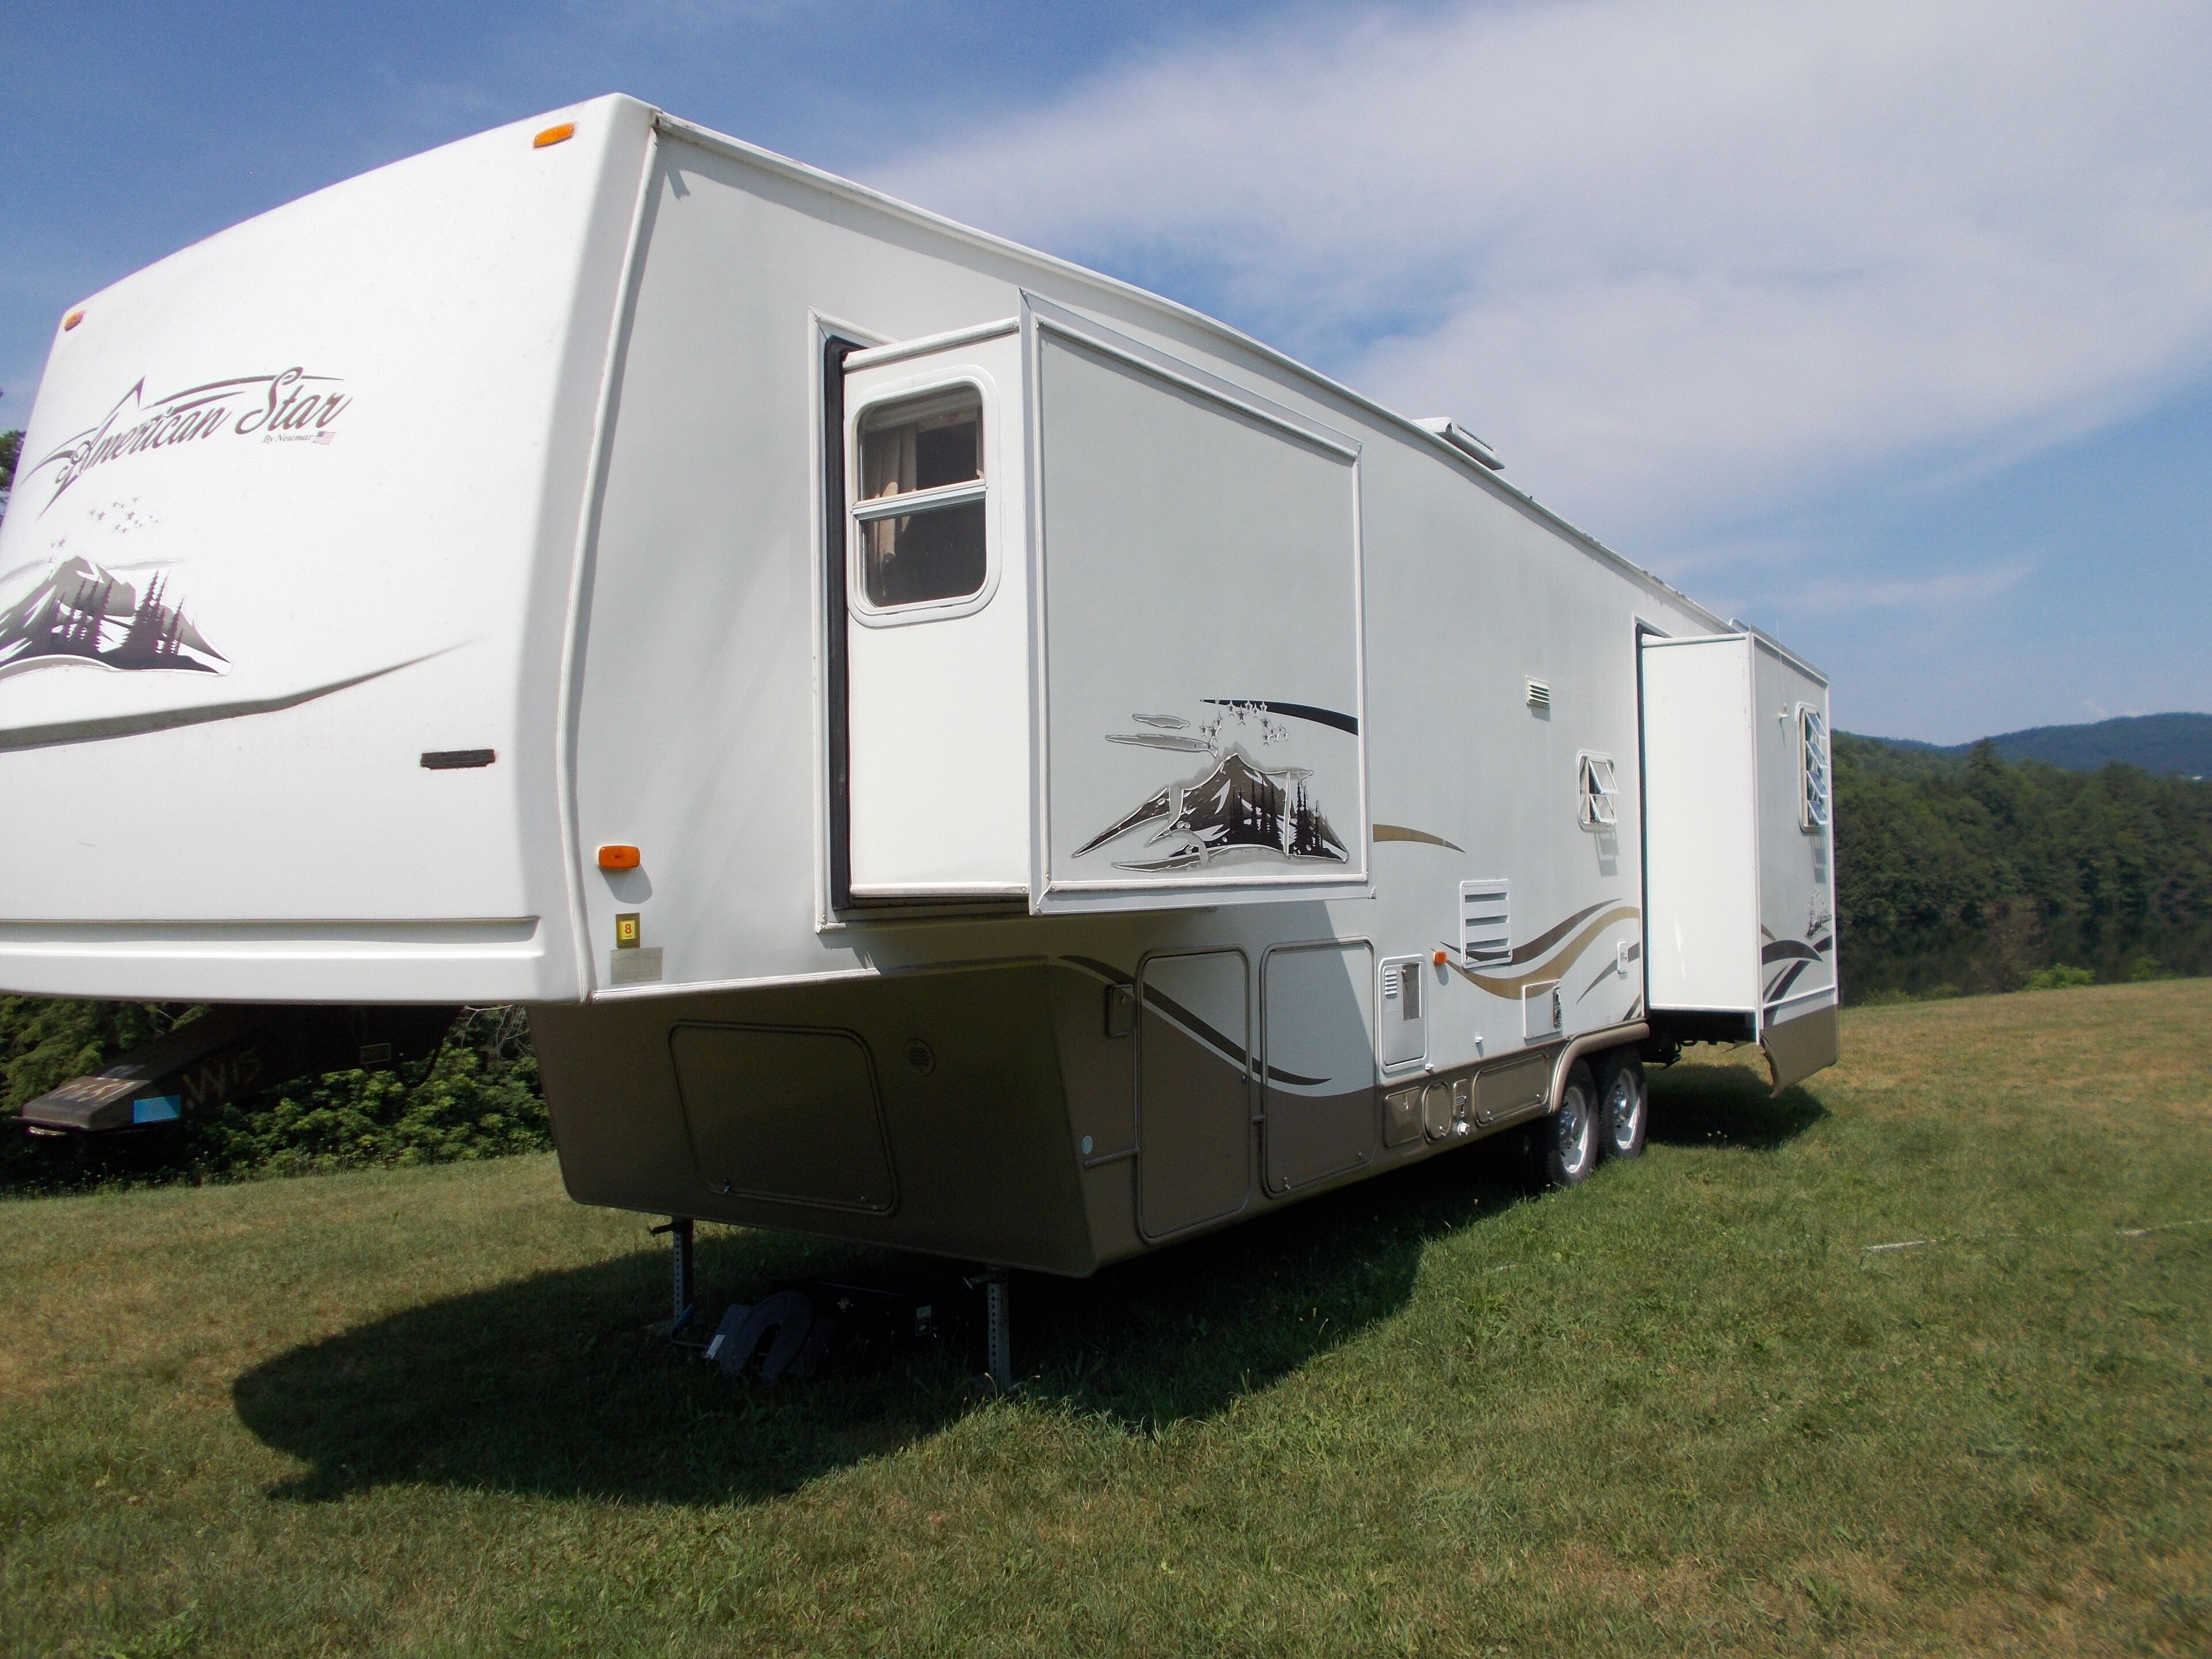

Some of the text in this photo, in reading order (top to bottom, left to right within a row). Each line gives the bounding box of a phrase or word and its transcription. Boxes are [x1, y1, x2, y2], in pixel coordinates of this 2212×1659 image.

[46, 366, 353, 495] American Star
[263, 433, 314, 445] By Newmar
[624, 923, 632, 934] 8
